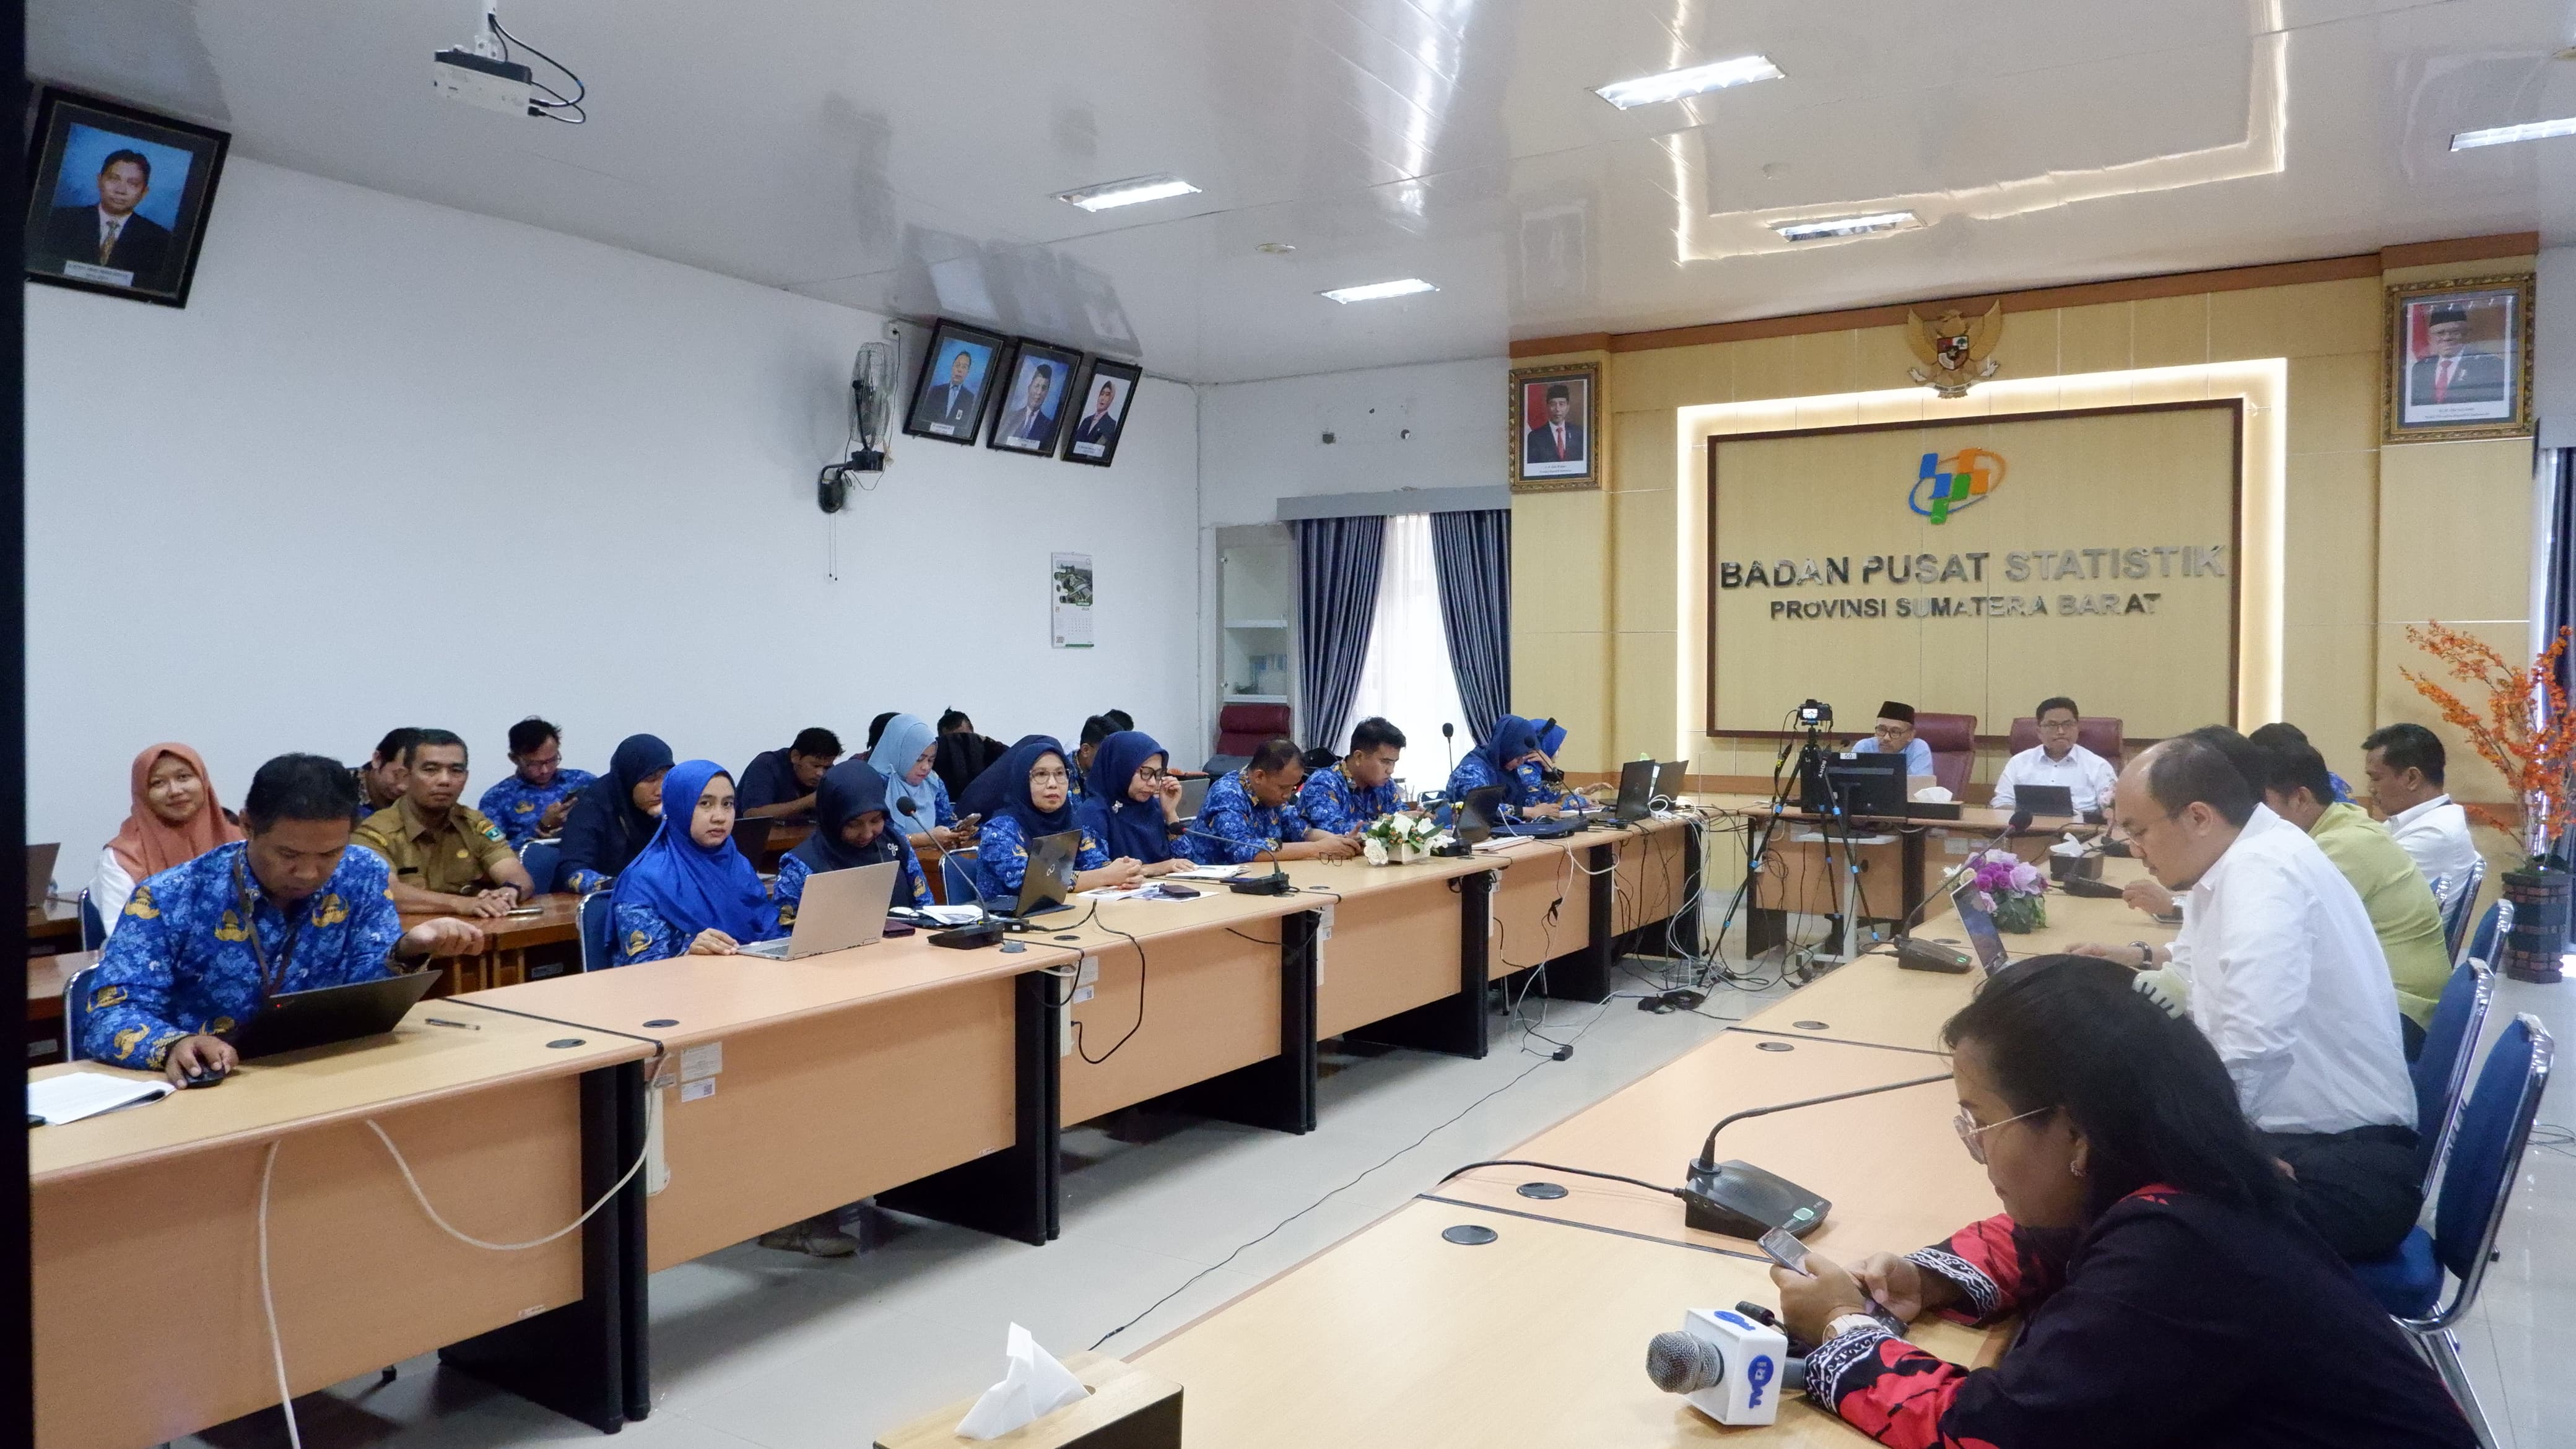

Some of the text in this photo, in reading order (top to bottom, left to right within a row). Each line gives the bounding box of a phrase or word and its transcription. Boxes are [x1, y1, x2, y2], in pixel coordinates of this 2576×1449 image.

[1720, 544, 2227, 589] BADAN PUSAT STATISTIK
[1770, 593, 2162, 620] PROVINSI SUMATERA BARAT
[1818, 760, 1827, 778] SONY
[1747, 1355, 1773, 1409] TVRI
